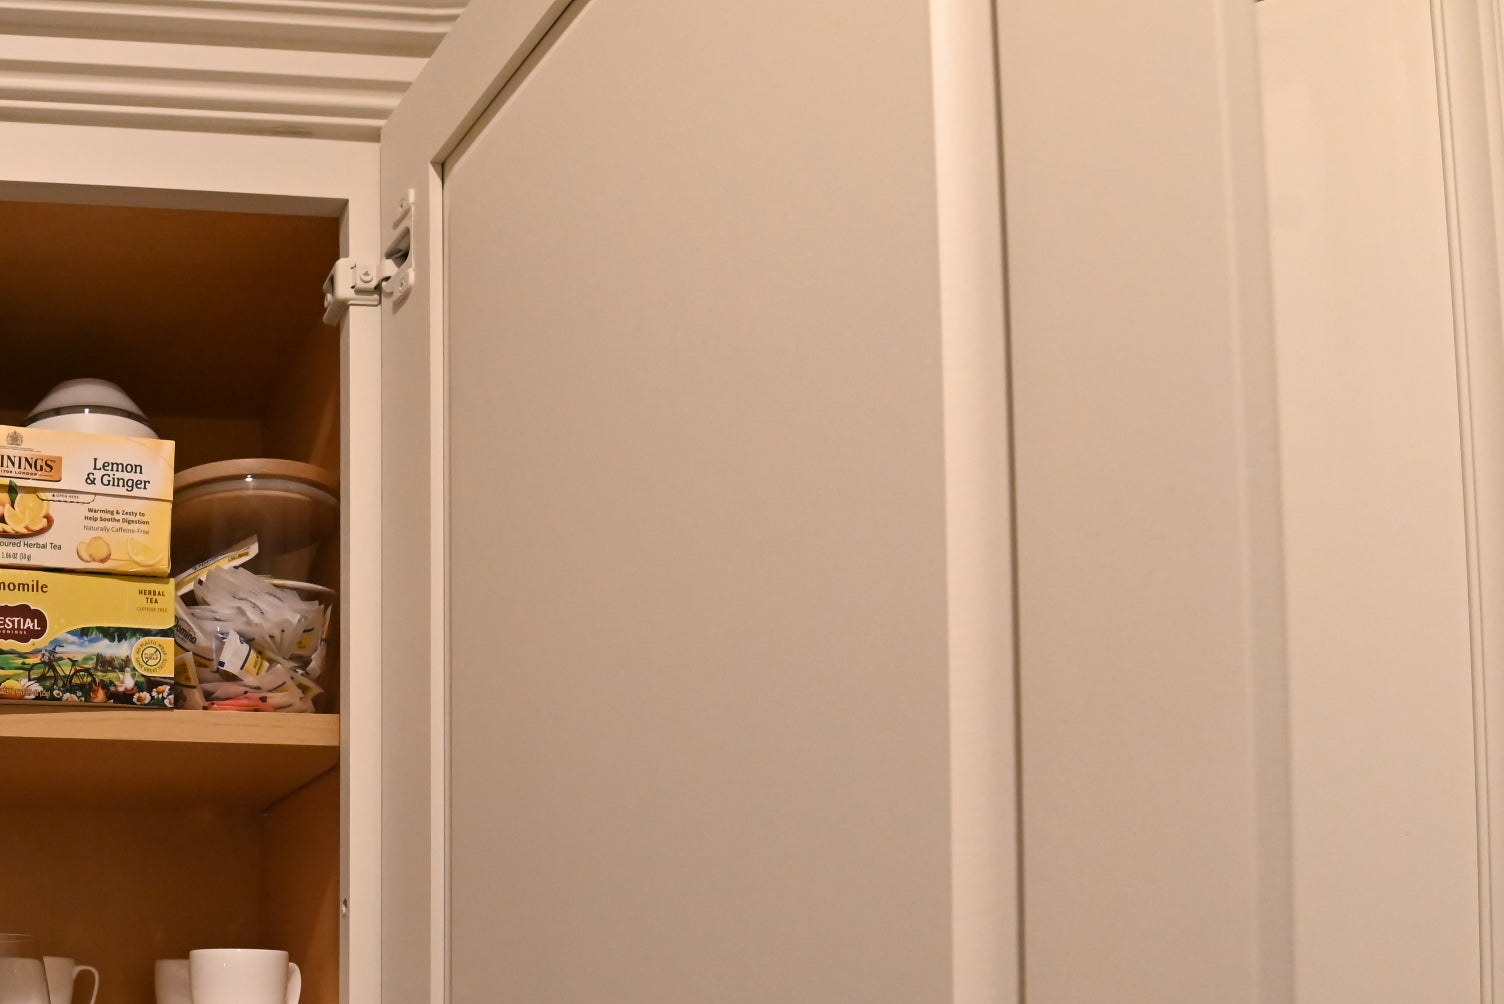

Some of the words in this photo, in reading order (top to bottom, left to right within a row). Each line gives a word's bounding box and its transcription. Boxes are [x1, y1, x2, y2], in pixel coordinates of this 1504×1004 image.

[92, 457, 143, 475] Lemon
[84, 472, 97, 486] &
[100, 473, 151, 492] Ginger
[87, 507, 115, 516] Warming
[121, 510, 138, 518] Zesty
[84, 515, 99, 523] Help
[99, 516, 121, 524] Soothe
[121, 517, 150, 526] Digestion
[83, 524, 110, 533] Naturally
[110, 526, 150, 535] Caffeine-Free
[23, 540, 48, 550] Herbal
[49, 542, 62, 551] Tea
[138, 588, 166, 597] HERBAL
[175, 615, 197, 644] omino
